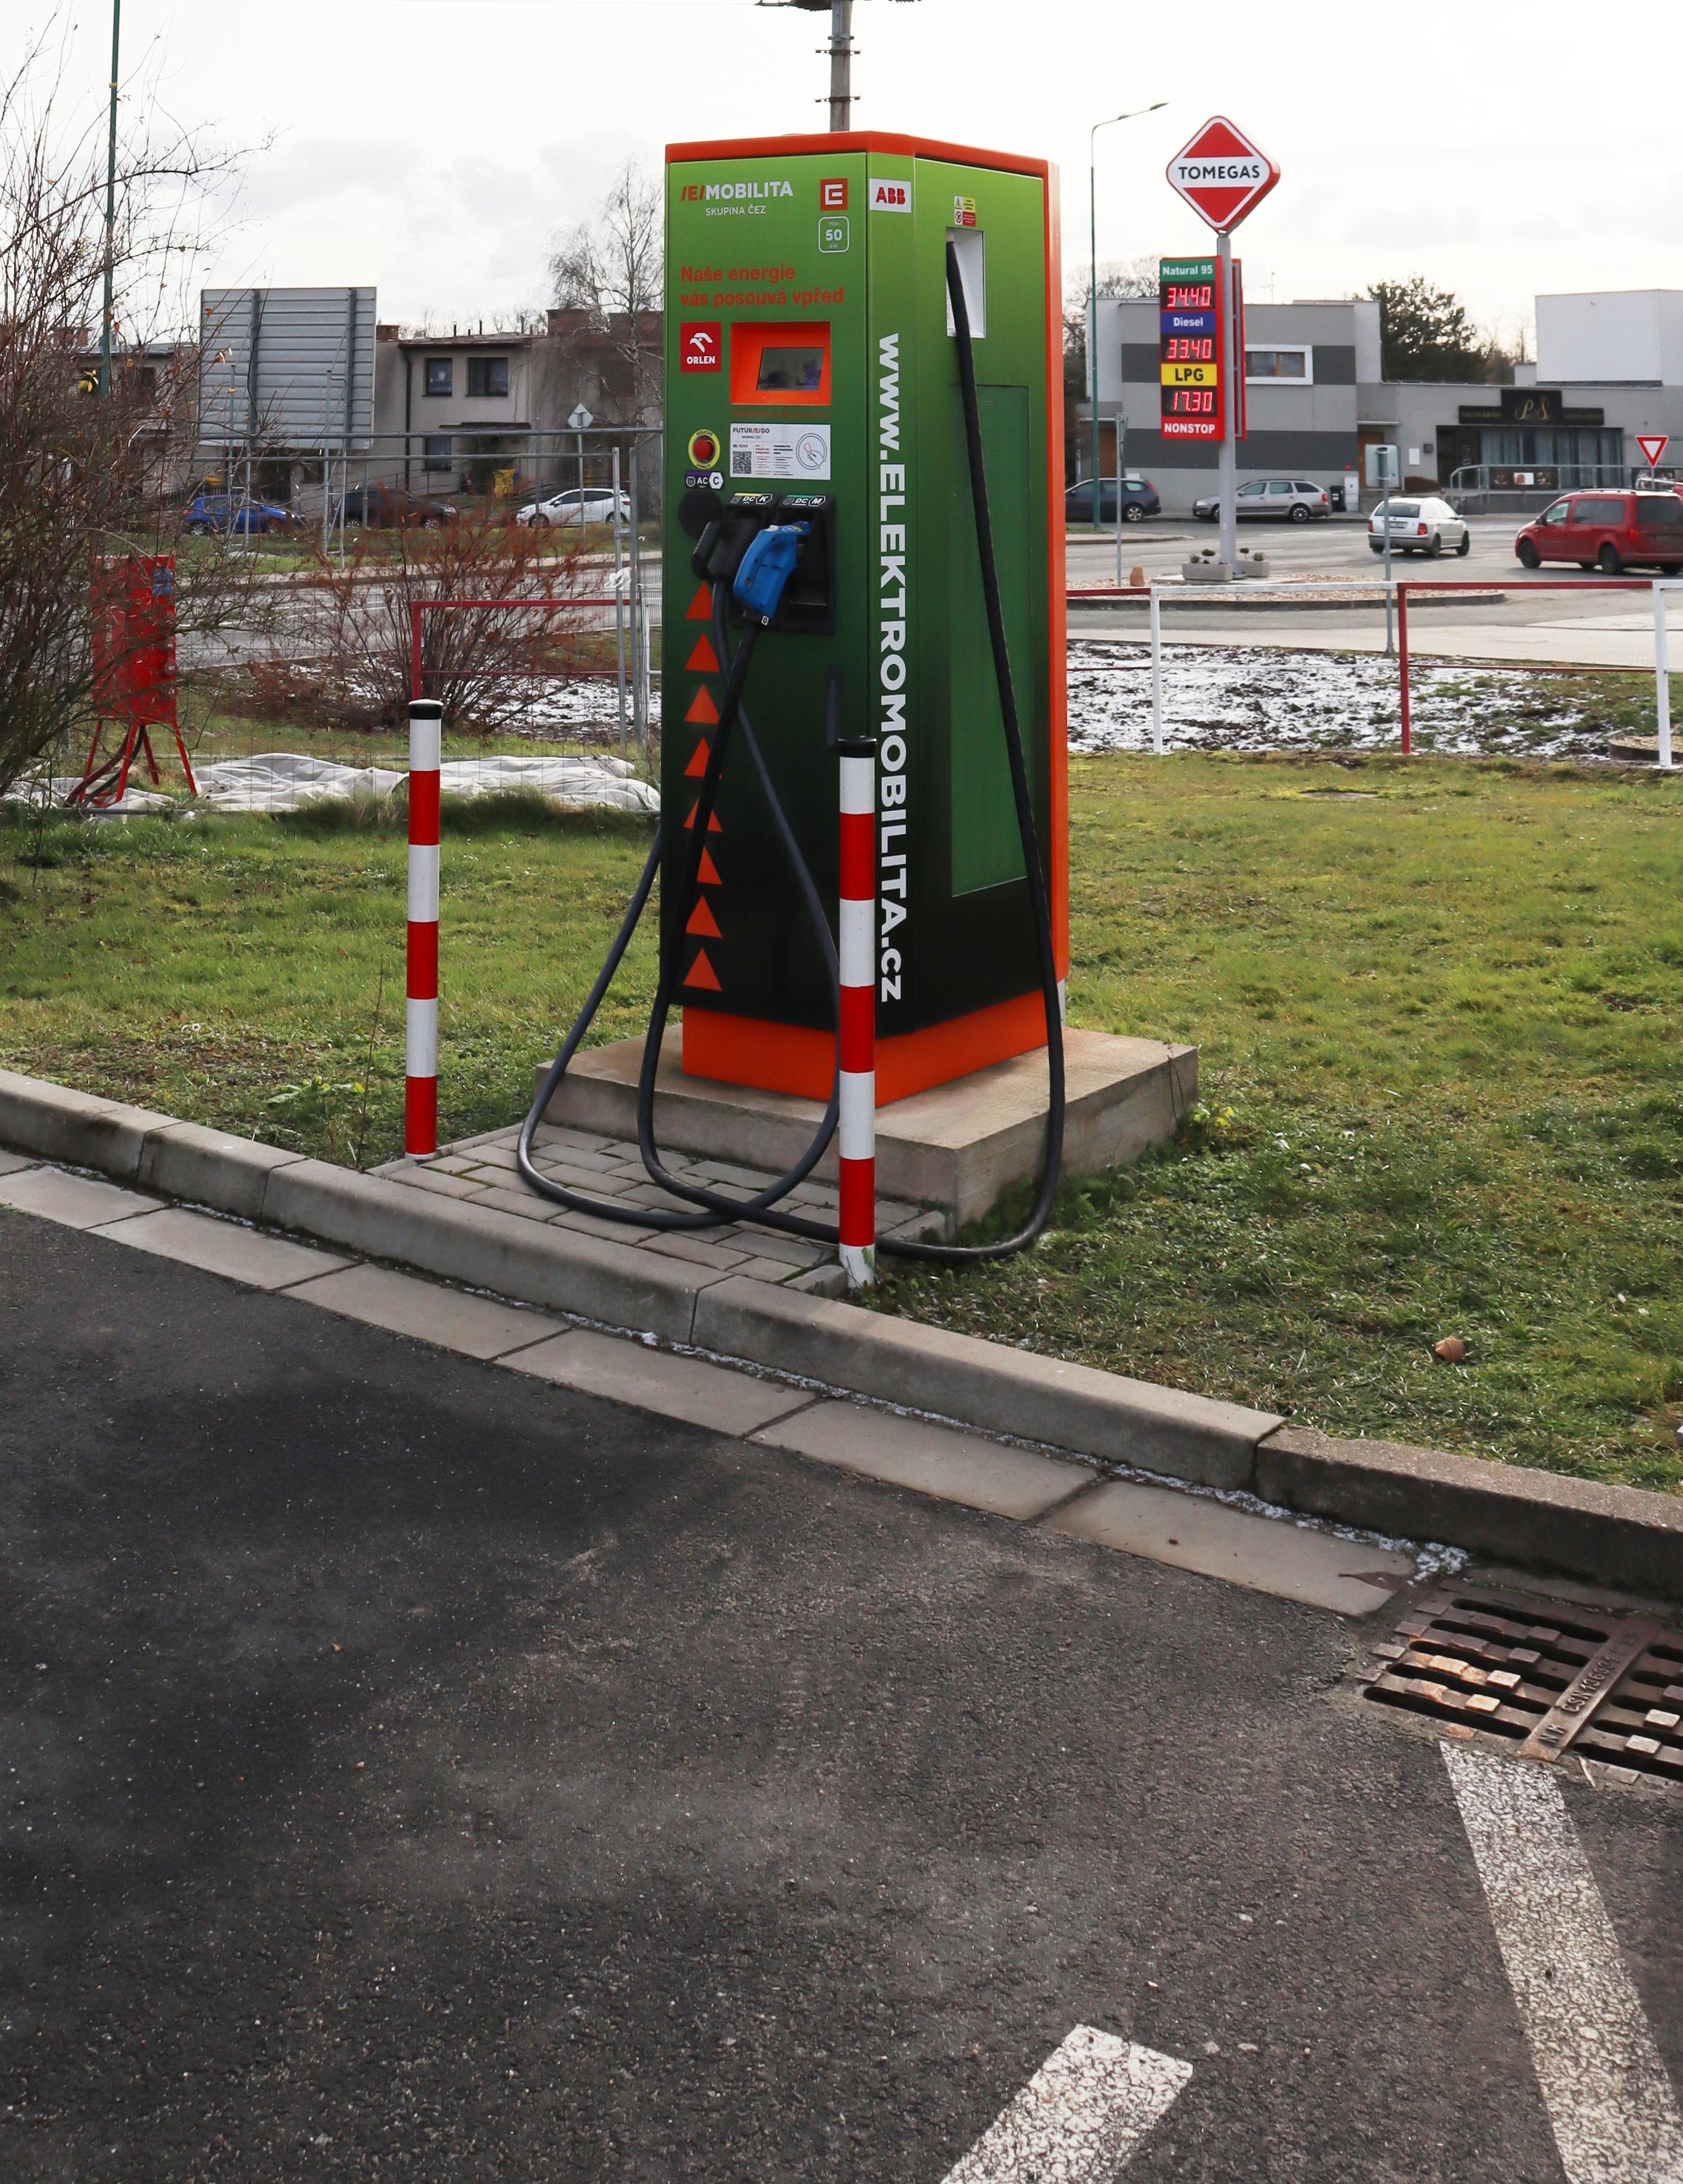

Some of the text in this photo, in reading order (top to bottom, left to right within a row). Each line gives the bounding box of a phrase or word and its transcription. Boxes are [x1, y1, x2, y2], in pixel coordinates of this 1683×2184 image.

[1178, 165, 1260, 179] TOMEGAS
[876, 186, 906, 205] ABB
[705, 205, 766, 216] SKUPINA ČEZ
[825, 229, 842, 241] 50
[681, 264, 796, 284] Naše energie
[1163, 264, 1213, 275] Natural 95
[680, 287, 844, 309] vás posouvá vpřed
[1167, 286, 1211, 308] 34.40
[1173, 317, 1203, 327] Diesel
[1167, 339, 1212, 359] 33.40
[686, 355, 716, 365] ORLEN
[1175, 368, 1204, 381] LPG
[1172, 391, 1213, 412] 17.30
[1164, 423, 1216, 434] NONSTOP
[697, 476, 720, 485] AC C
